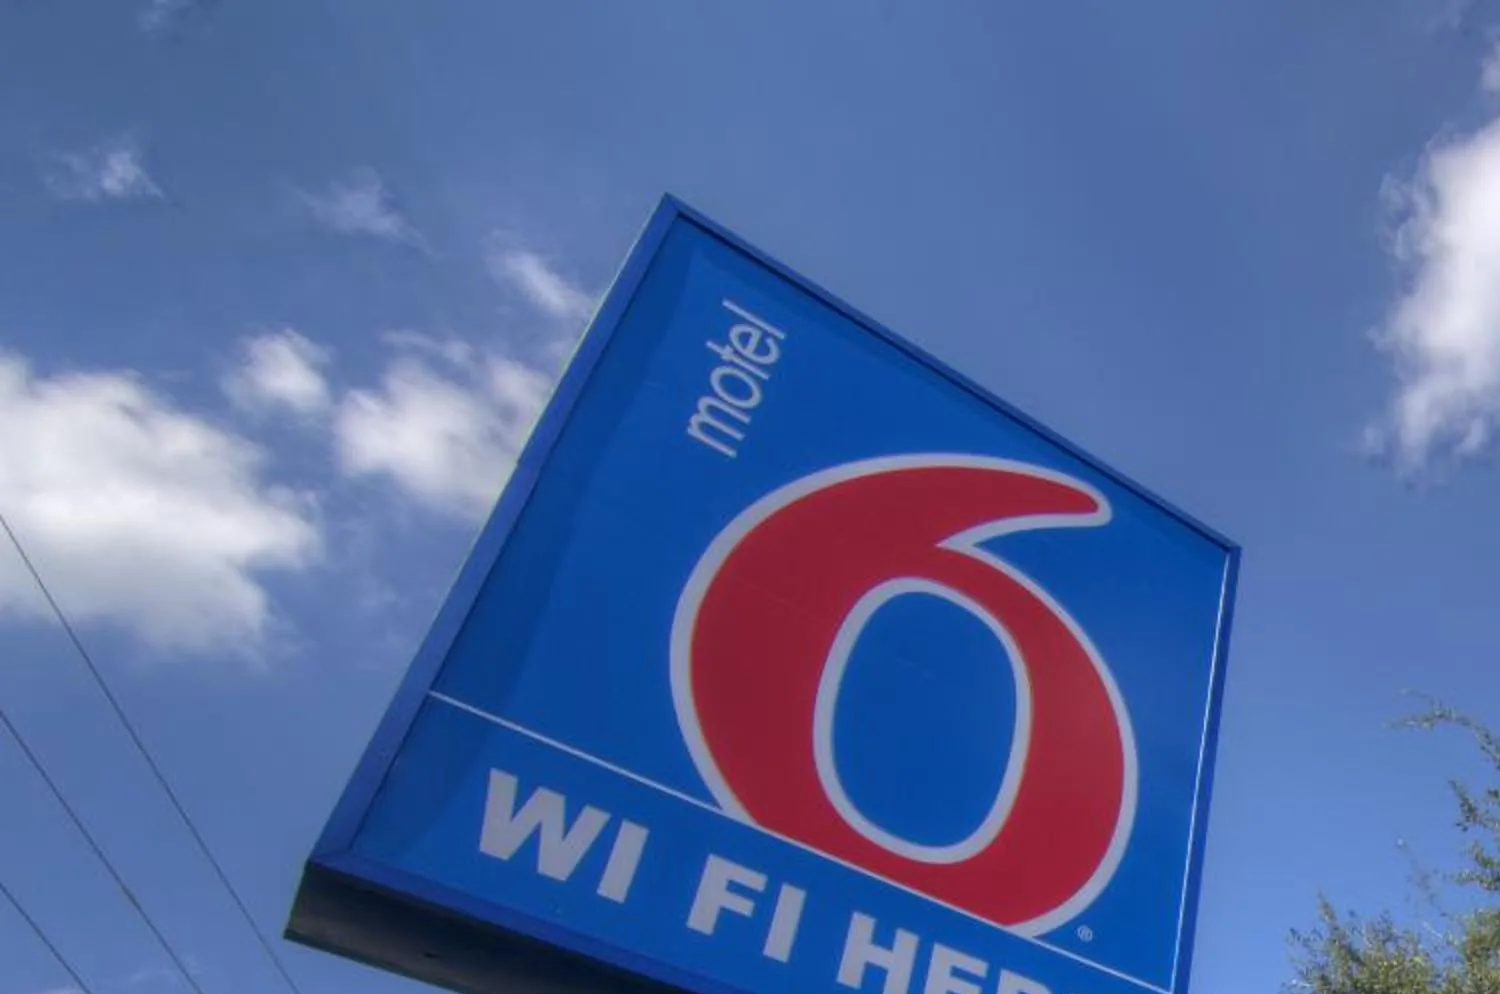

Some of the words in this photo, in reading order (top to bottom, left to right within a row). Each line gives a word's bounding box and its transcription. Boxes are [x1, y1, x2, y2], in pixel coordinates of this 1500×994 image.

[686, 299, 786, 458] motel
[670, 454, 1139, 938] 6
[479, 768, 648, 903] WI
[687, 854, 806, 963] FI
